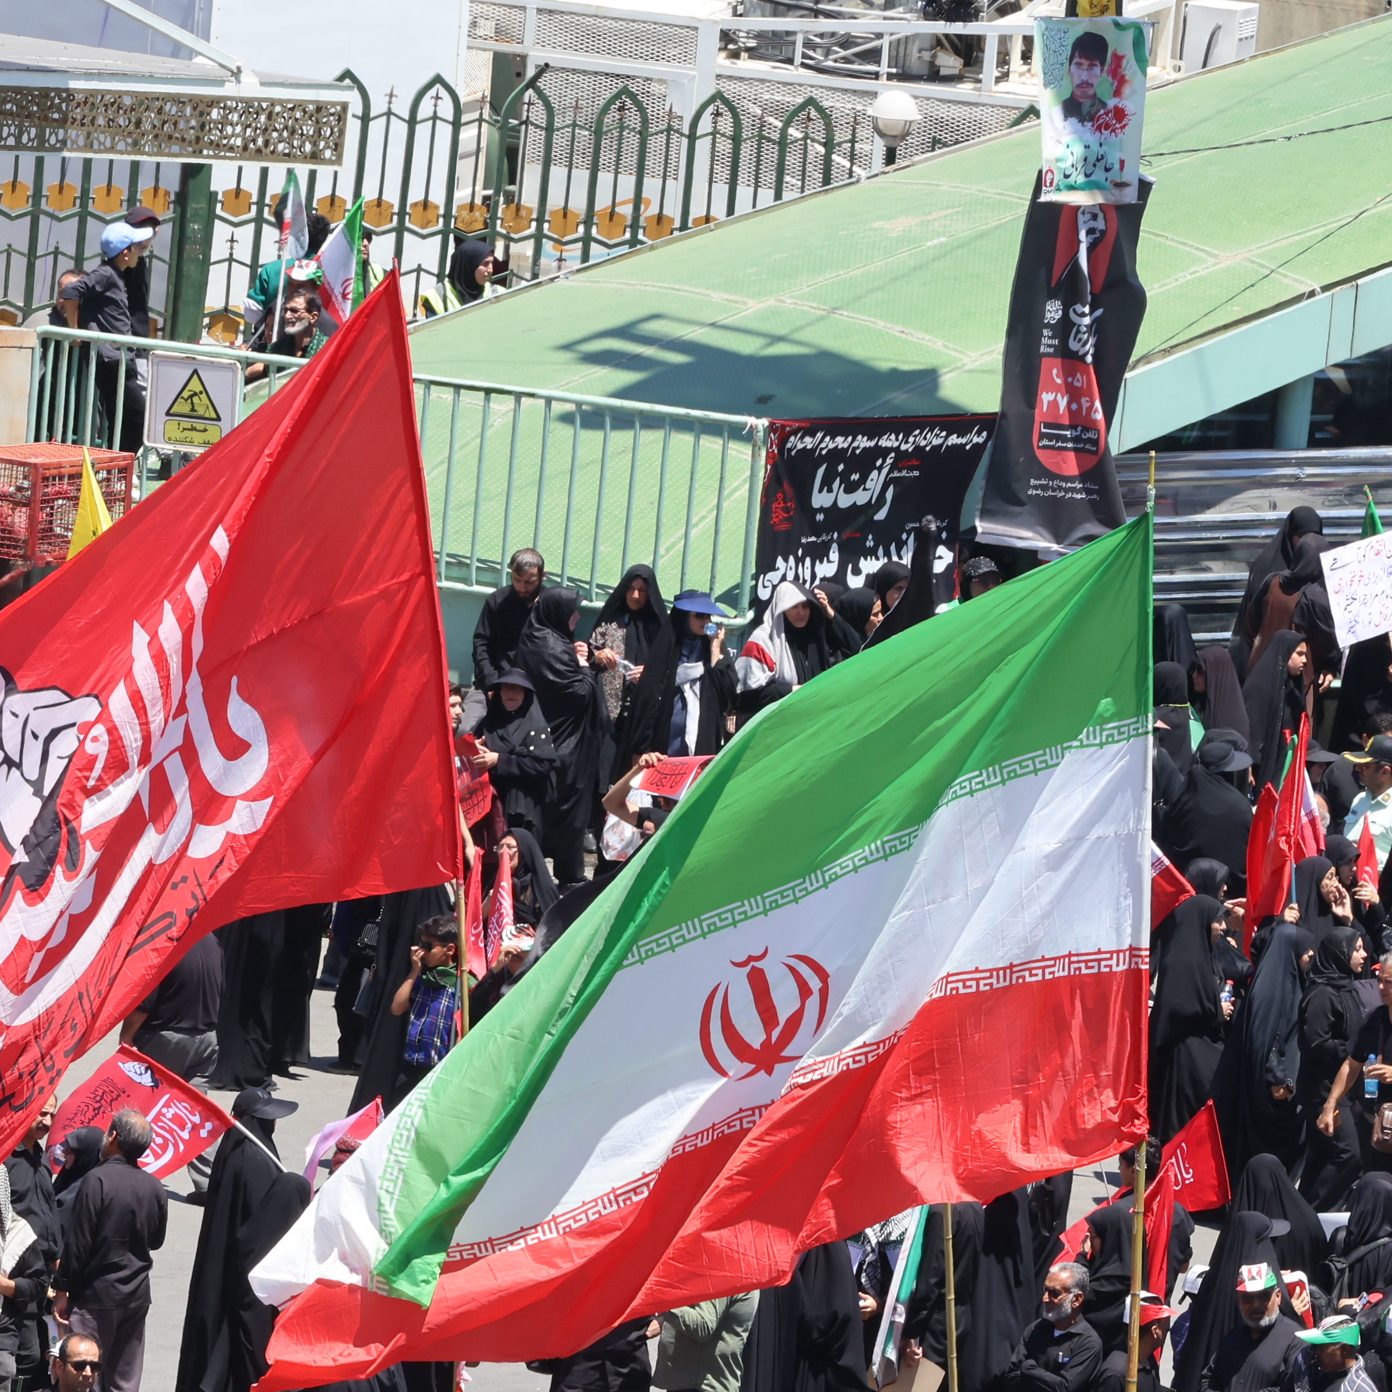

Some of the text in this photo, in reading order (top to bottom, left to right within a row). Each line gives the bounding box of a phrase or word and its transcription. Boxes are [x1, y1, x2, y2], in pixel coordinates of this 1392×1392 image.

[1042, 328, 1053, 337] We
[1041, 336, 1059, 345] Must
[1040, 345, 1055, 353] Rise
[1041, 390, 1103, 420] ۳۷۰۴۵
[177, 422, 208, 433] خطر!
[1081, 430, 1098, 439] تلفن
[168, 435, 195, 444] شکننده
[785, 425, 987, 459] مراسم عزاداری دهه سوم محرم الحرام
